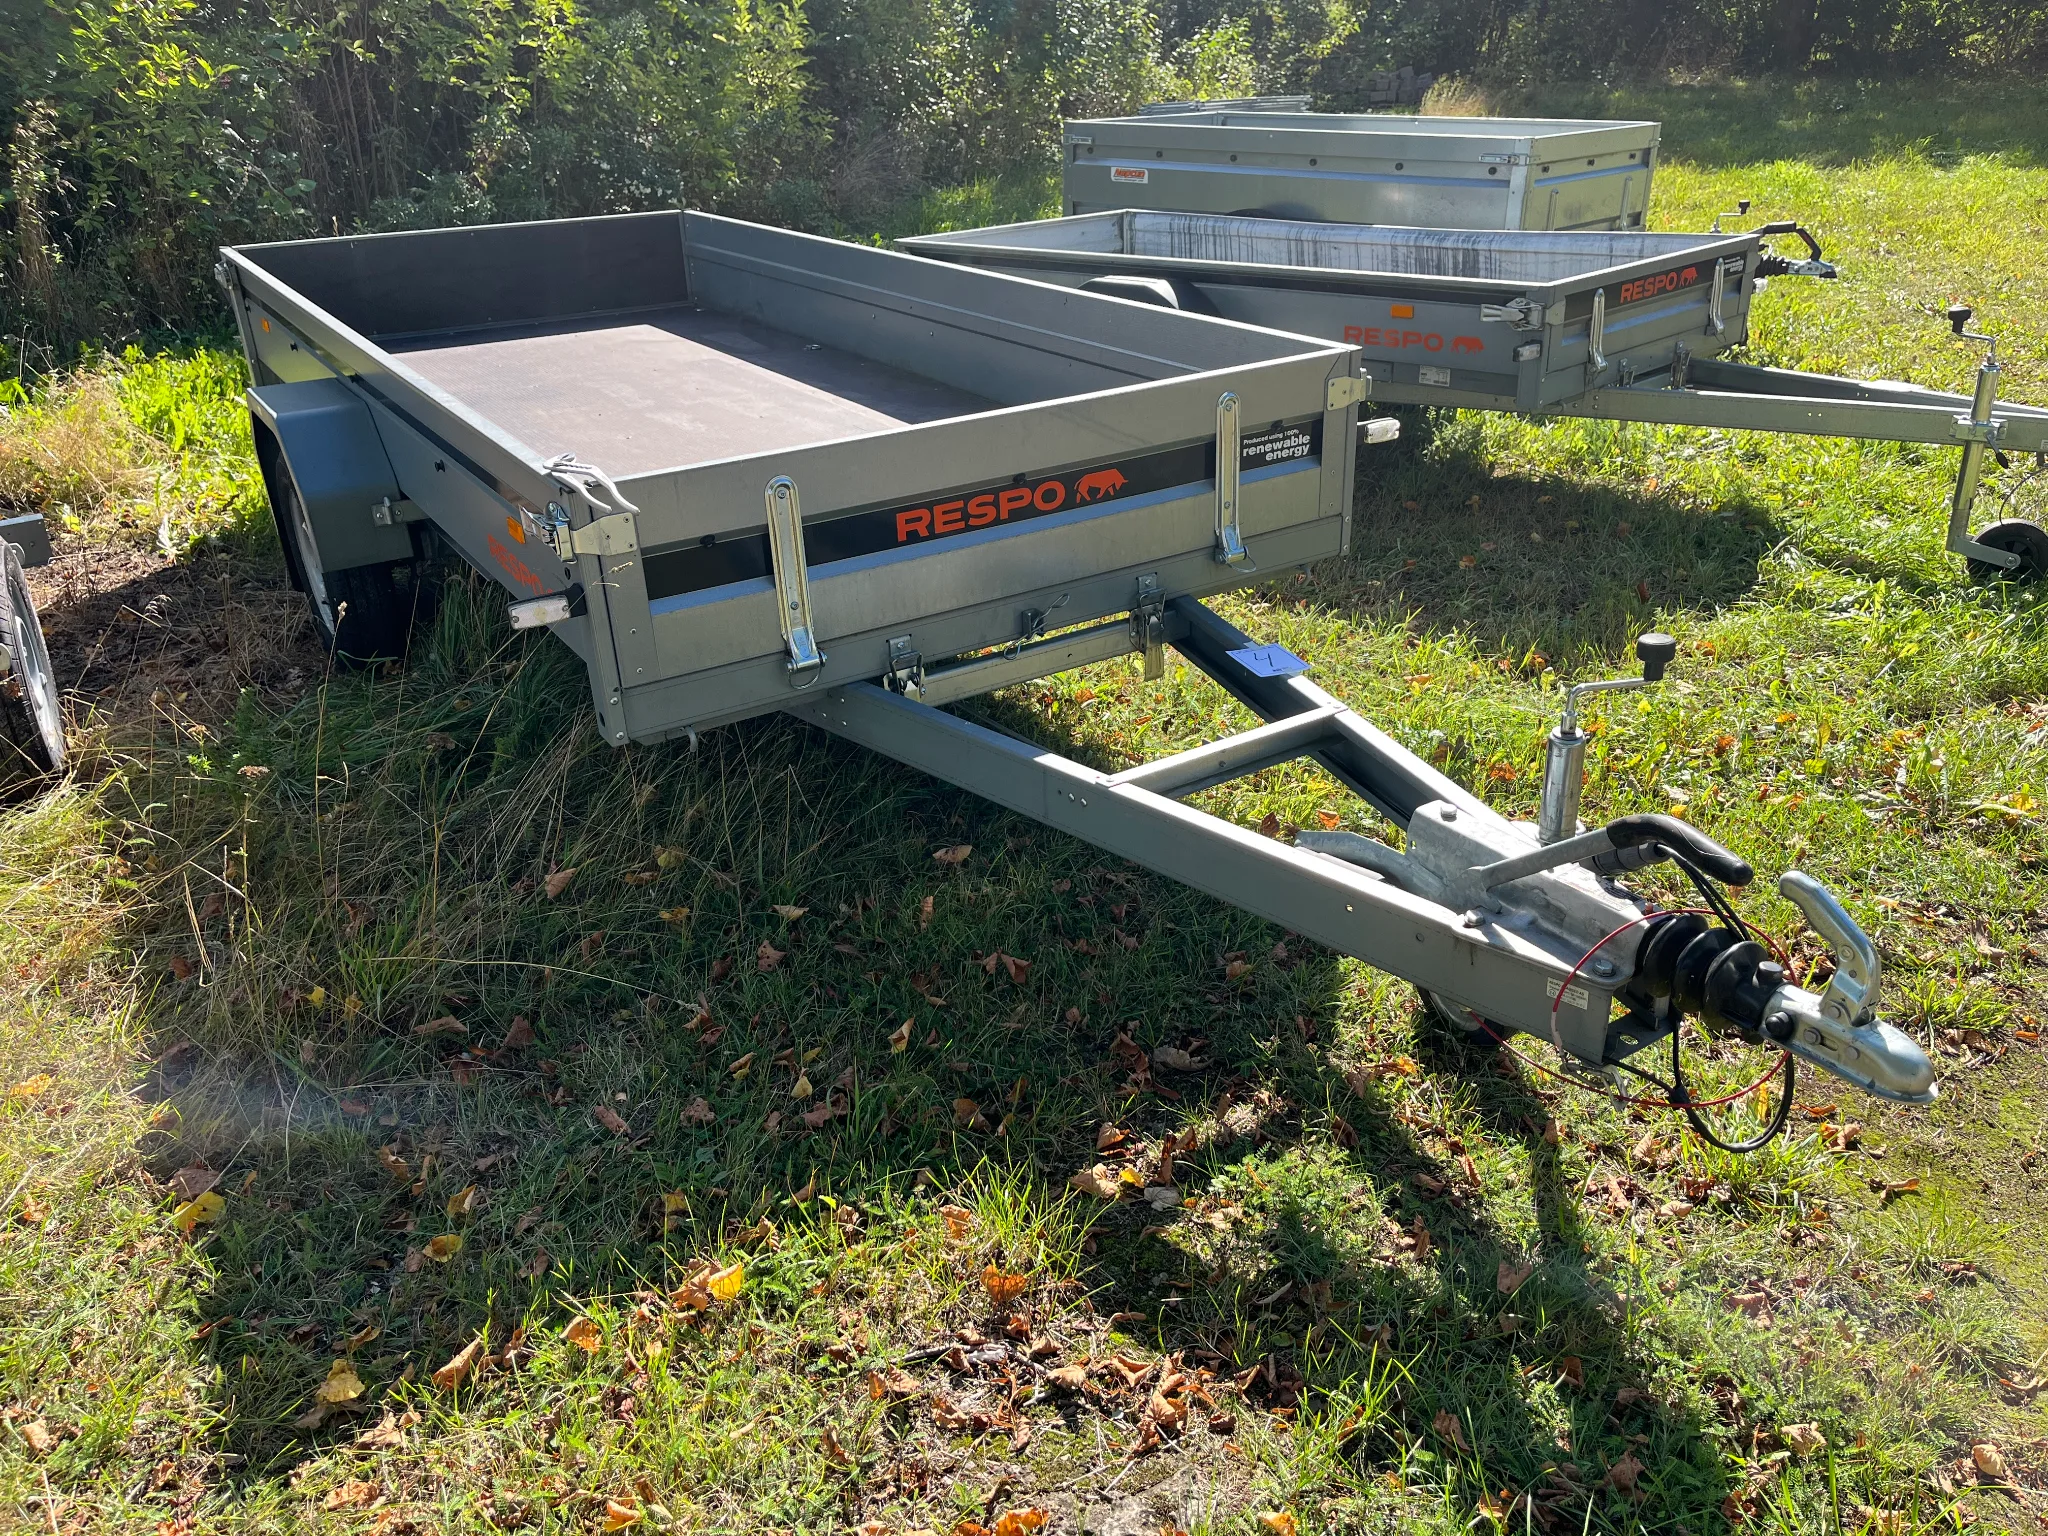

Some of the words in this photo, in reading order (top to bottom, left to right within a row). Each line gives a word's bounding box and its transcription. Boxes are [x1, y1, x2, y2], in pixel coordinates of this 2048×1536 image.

[1620, 271, 1678, 304] RESPO
[1344, 325, 1444, 352] RESPO
[1242, 434, 1311, 457] renewable
[1243, 435, 1268, 445] Produced
[1265, 444, 1310, 461] energy
[895, 480, 1066, 542] RESPO
[487, 532, 546, 598] RESPO
